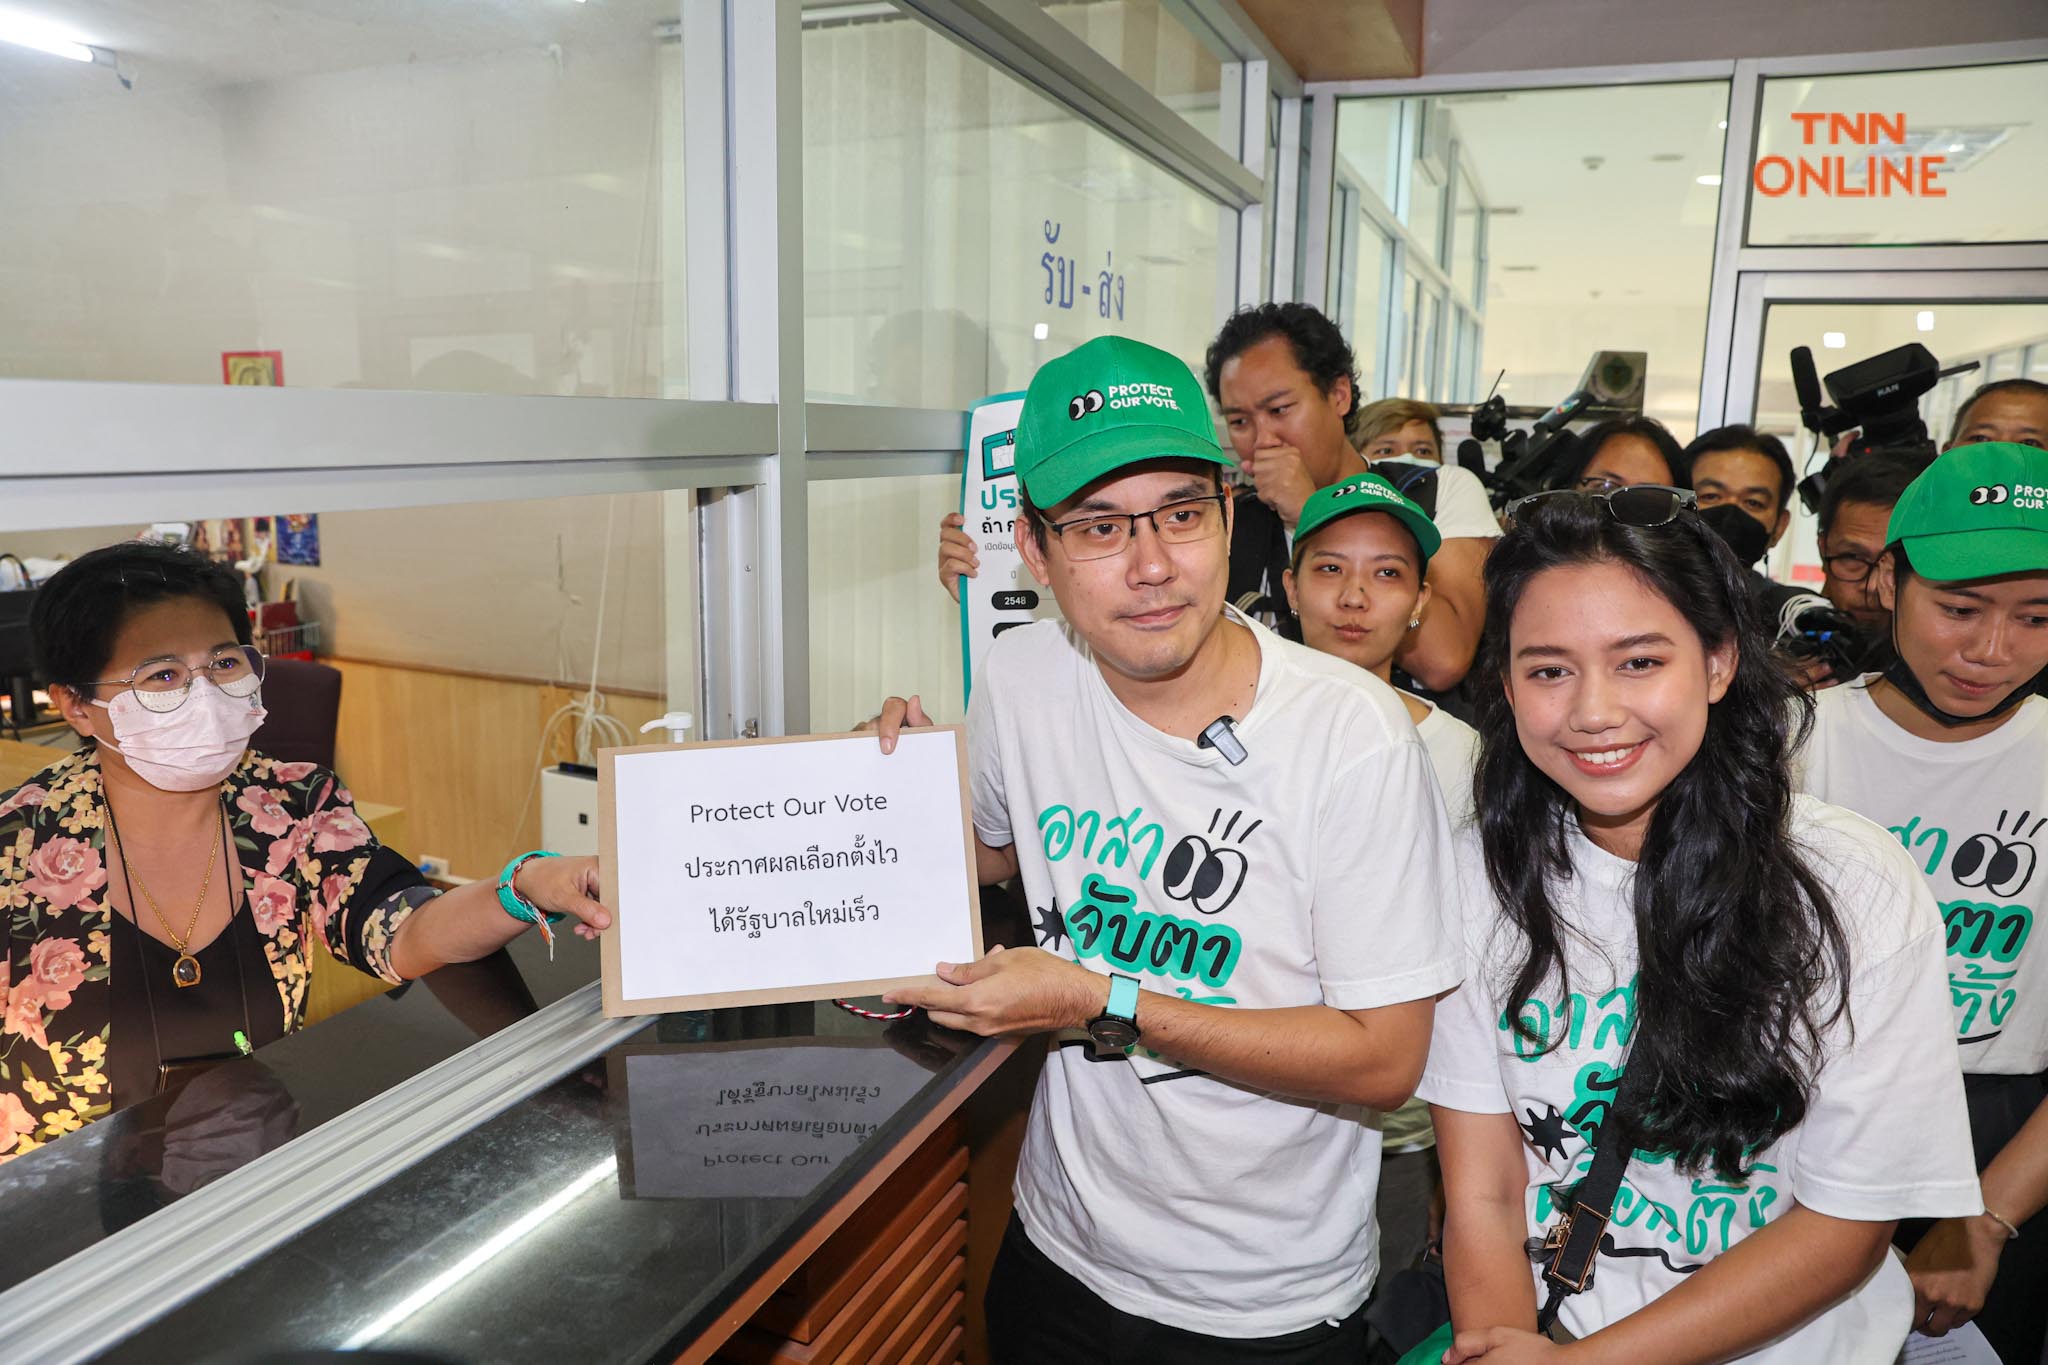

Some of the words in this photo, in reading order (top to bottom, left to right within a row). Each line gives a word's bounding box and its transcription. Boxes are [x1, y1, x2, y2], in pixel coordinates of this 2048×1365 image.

[1108, 383, 1173, 398] PROTECT
[1110, 396, 1141, 409] OUR
[1360, 488, 1383, 497] OUR
[2013, 497, 2045, 510] OUR
[982, 516, 1003, 533] ถ้า
[1004, 596, 1026, 605] 2548
[690, 800, 775, 823] Protect
[784, 798, 826, 817] Our
[834, 793, 888, 812] Vote
[1038, 804, 1164, 880] อาสา
[684, 834, 899, 879] ประกาศผลเลือกตั้งไว
[709, 895, 880, 939] ได้รัฐบาลใหม่เร็ว
[1069, 880, 1231, 978] จับตา
